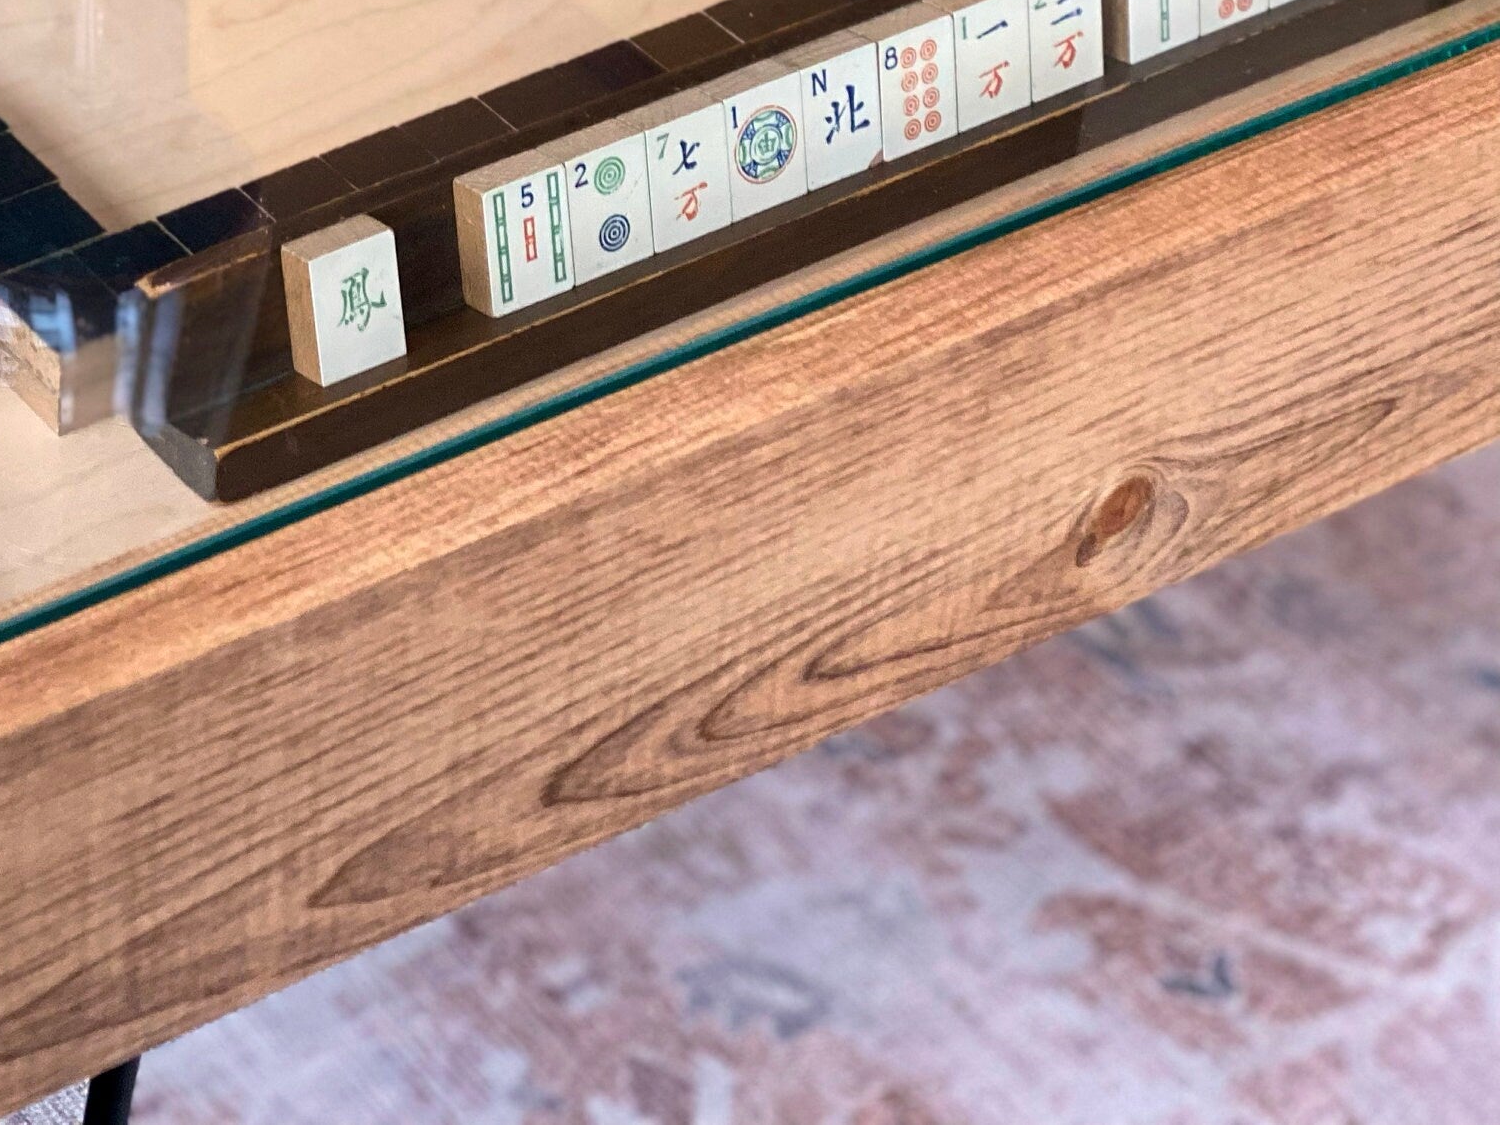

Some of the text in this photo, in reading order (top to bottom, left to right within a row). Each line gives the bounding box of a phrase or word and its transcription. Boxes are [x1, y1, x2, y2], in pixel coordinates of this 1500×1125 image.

[960, 15, 969, 41] 1
[884, 45, 899, 71] 8
[810, 67, 829, 98] N
[731, 104, 740, 130] 1
[824, 83, 871, 145] 北
[655, 131, 670, 162] 7
[573, 161, 589, 190] 2
[520, 181, 536, 210] 5
